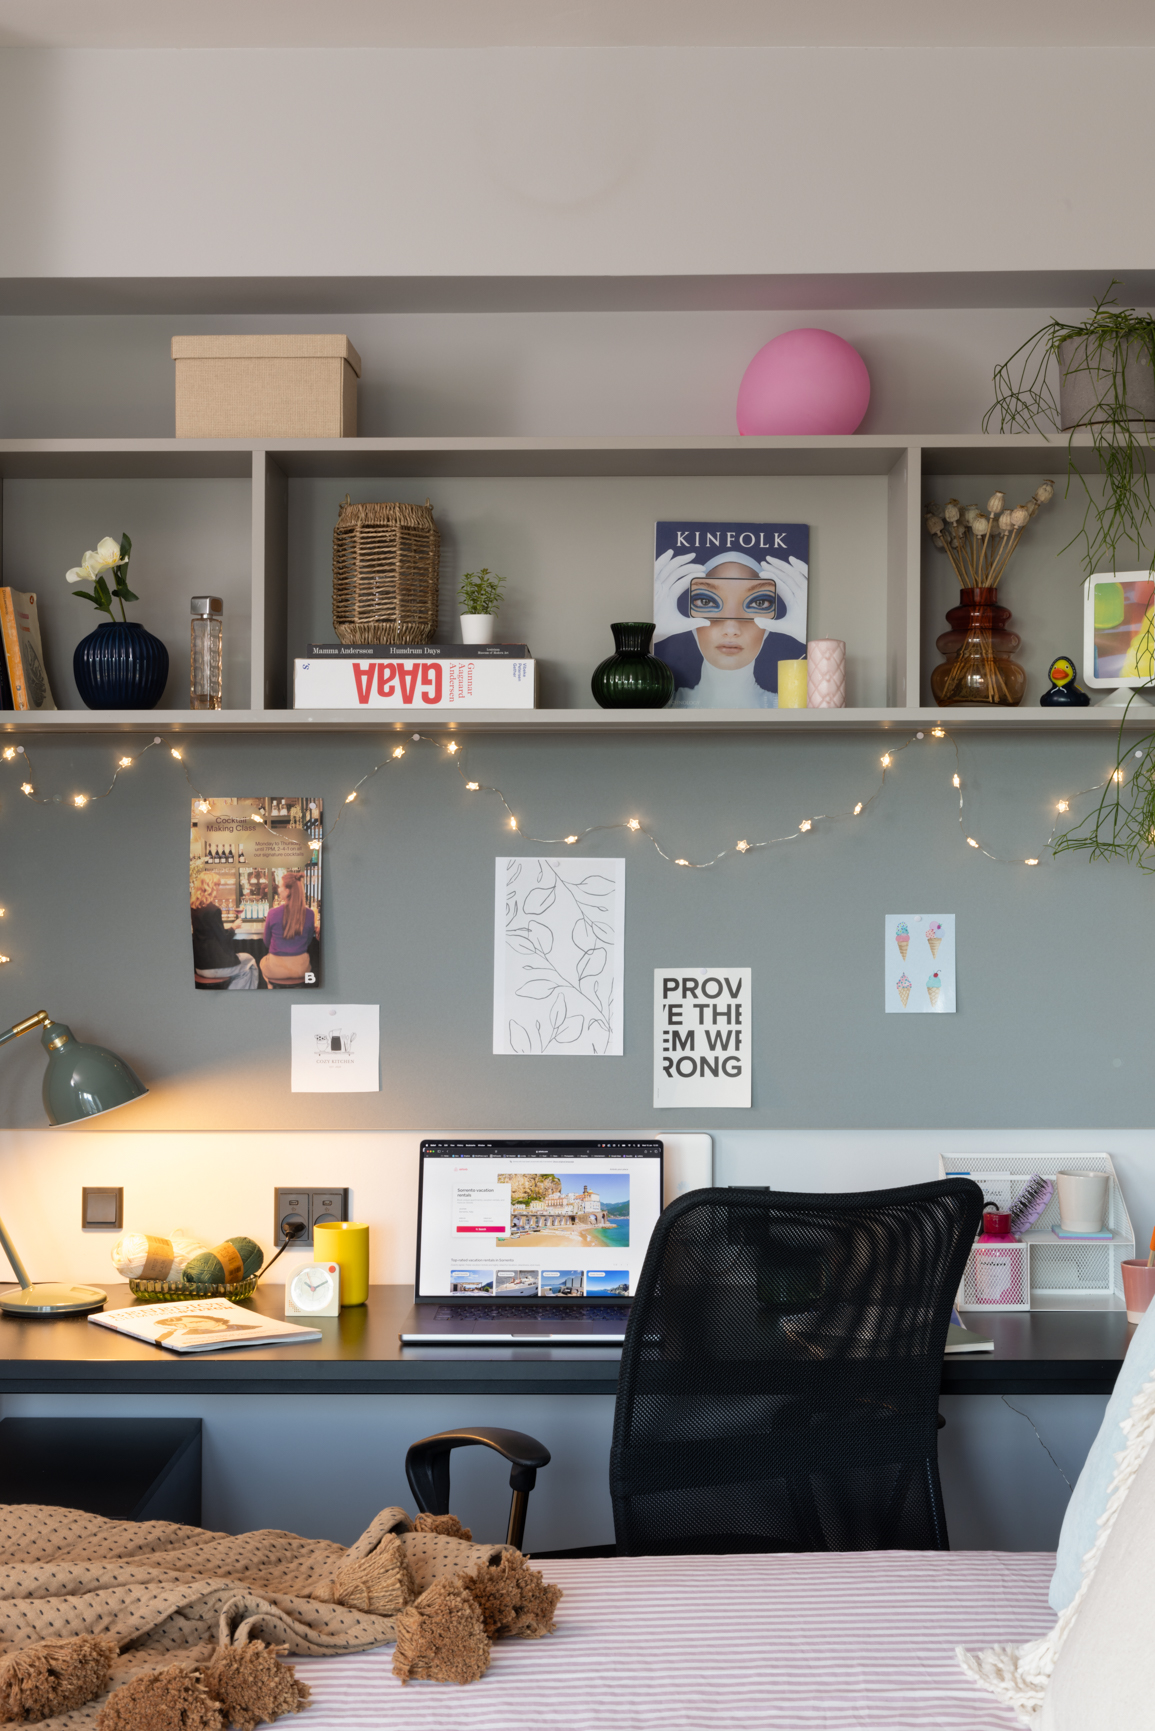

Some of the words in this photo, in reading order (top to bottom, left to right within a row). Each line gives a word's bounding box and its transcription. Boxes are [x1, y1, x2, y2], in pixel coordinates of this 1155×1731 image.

[676, 532, 788, 548] KINFOLK
[424, 647, 440, 655] Days
[458, 662, 466, 698] Aagaard
[467, 662, 475, 696] Gunnar
[304, 972, 316, 984] B
[663, 977, 742, 999] PROV
[663, 1056, 742, 1078] RONG
